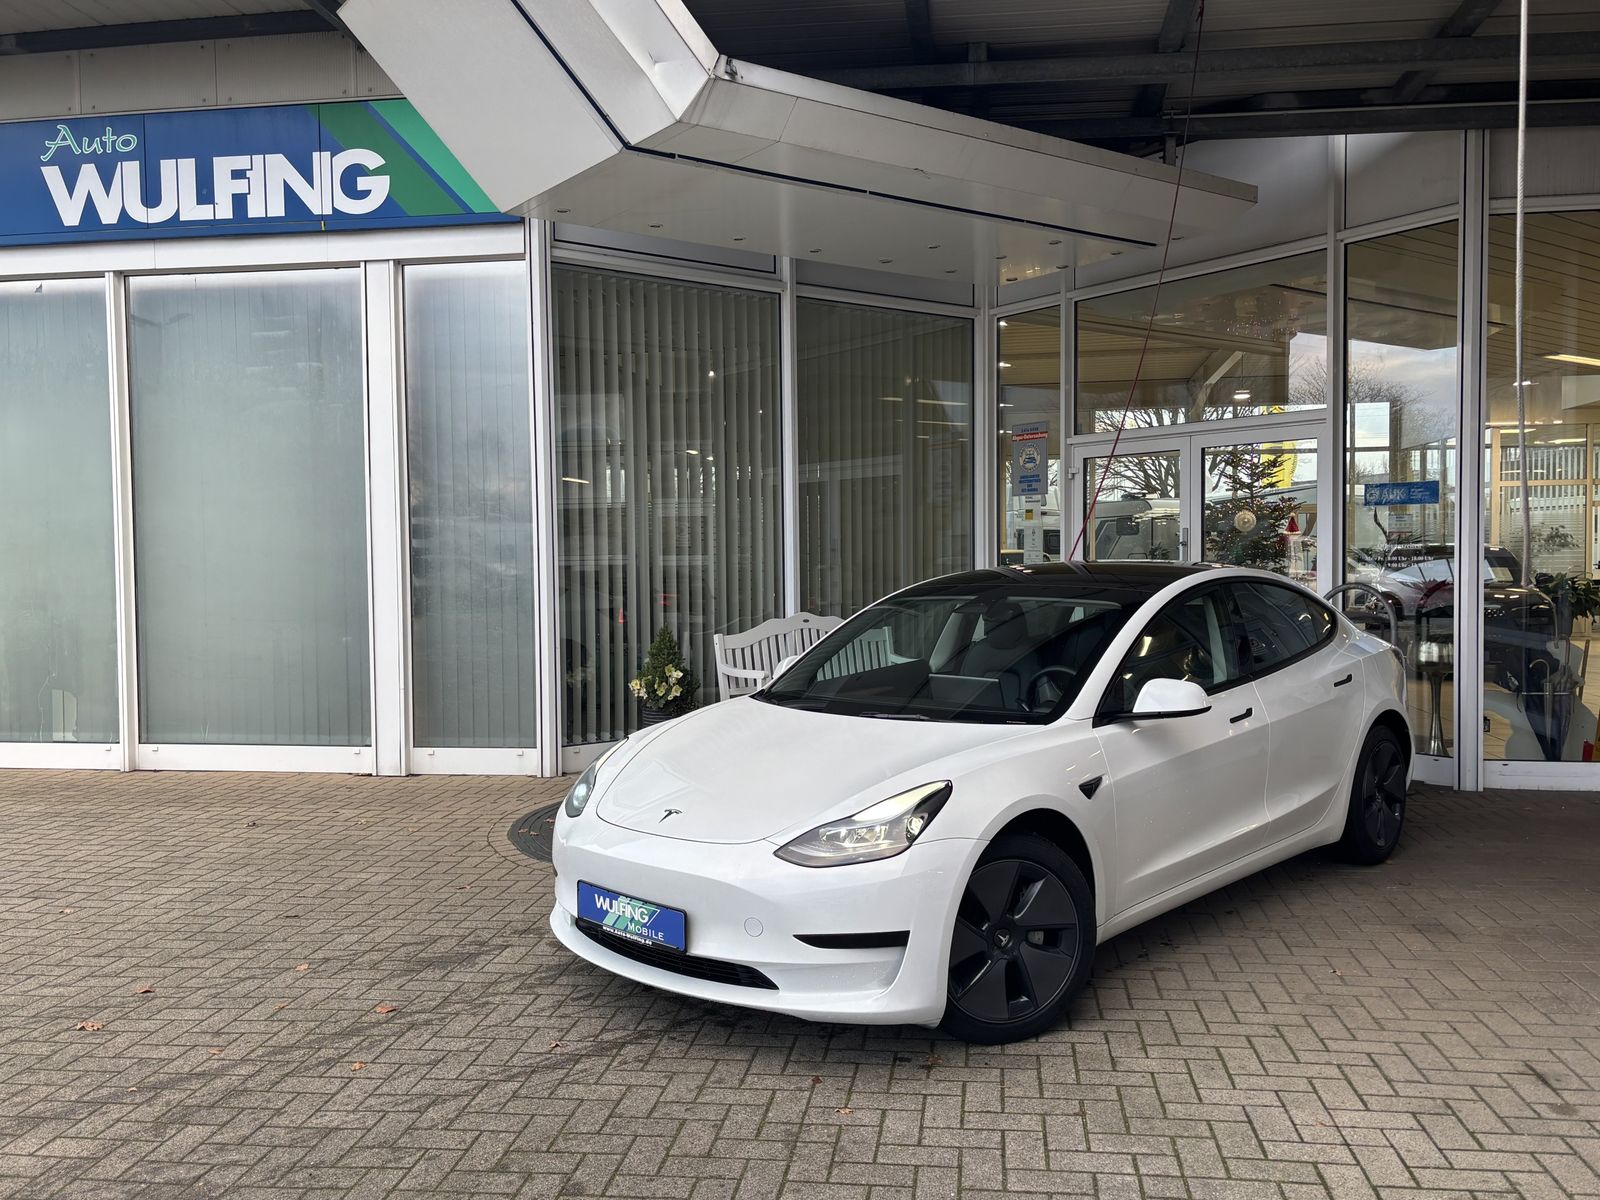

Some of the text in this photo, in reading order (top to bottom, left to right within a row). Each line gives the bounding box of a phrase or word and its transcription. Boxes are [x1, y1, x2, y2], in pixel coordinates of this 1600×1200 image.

[40, 124, 137, 161] Auto
[40, 148, 390, 227] WULFING
[594, 893, 649, 923] WULFING
[627, 921, 664, 941] MOBILE
